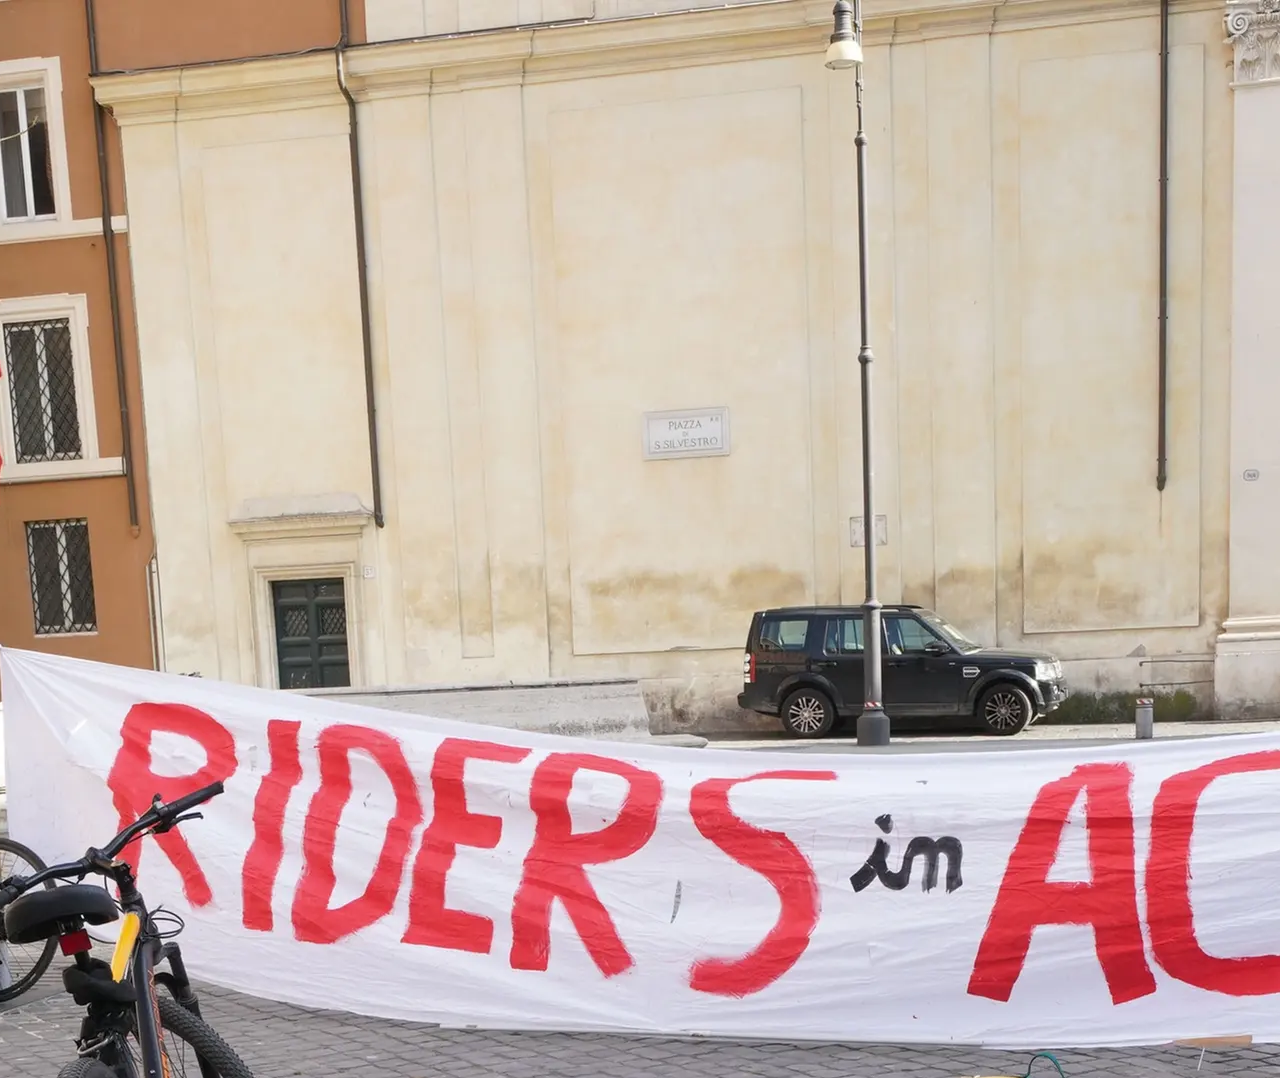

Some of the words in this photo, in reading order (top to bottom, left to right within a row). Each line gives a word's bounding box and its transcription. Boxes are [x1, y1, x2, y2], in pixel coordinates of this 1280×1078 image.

[668, 419, 702, 431] PIAZZA
[663, 436, 719, 449] SILVESTRO
[107, 702, 837, 999] RIDERS
